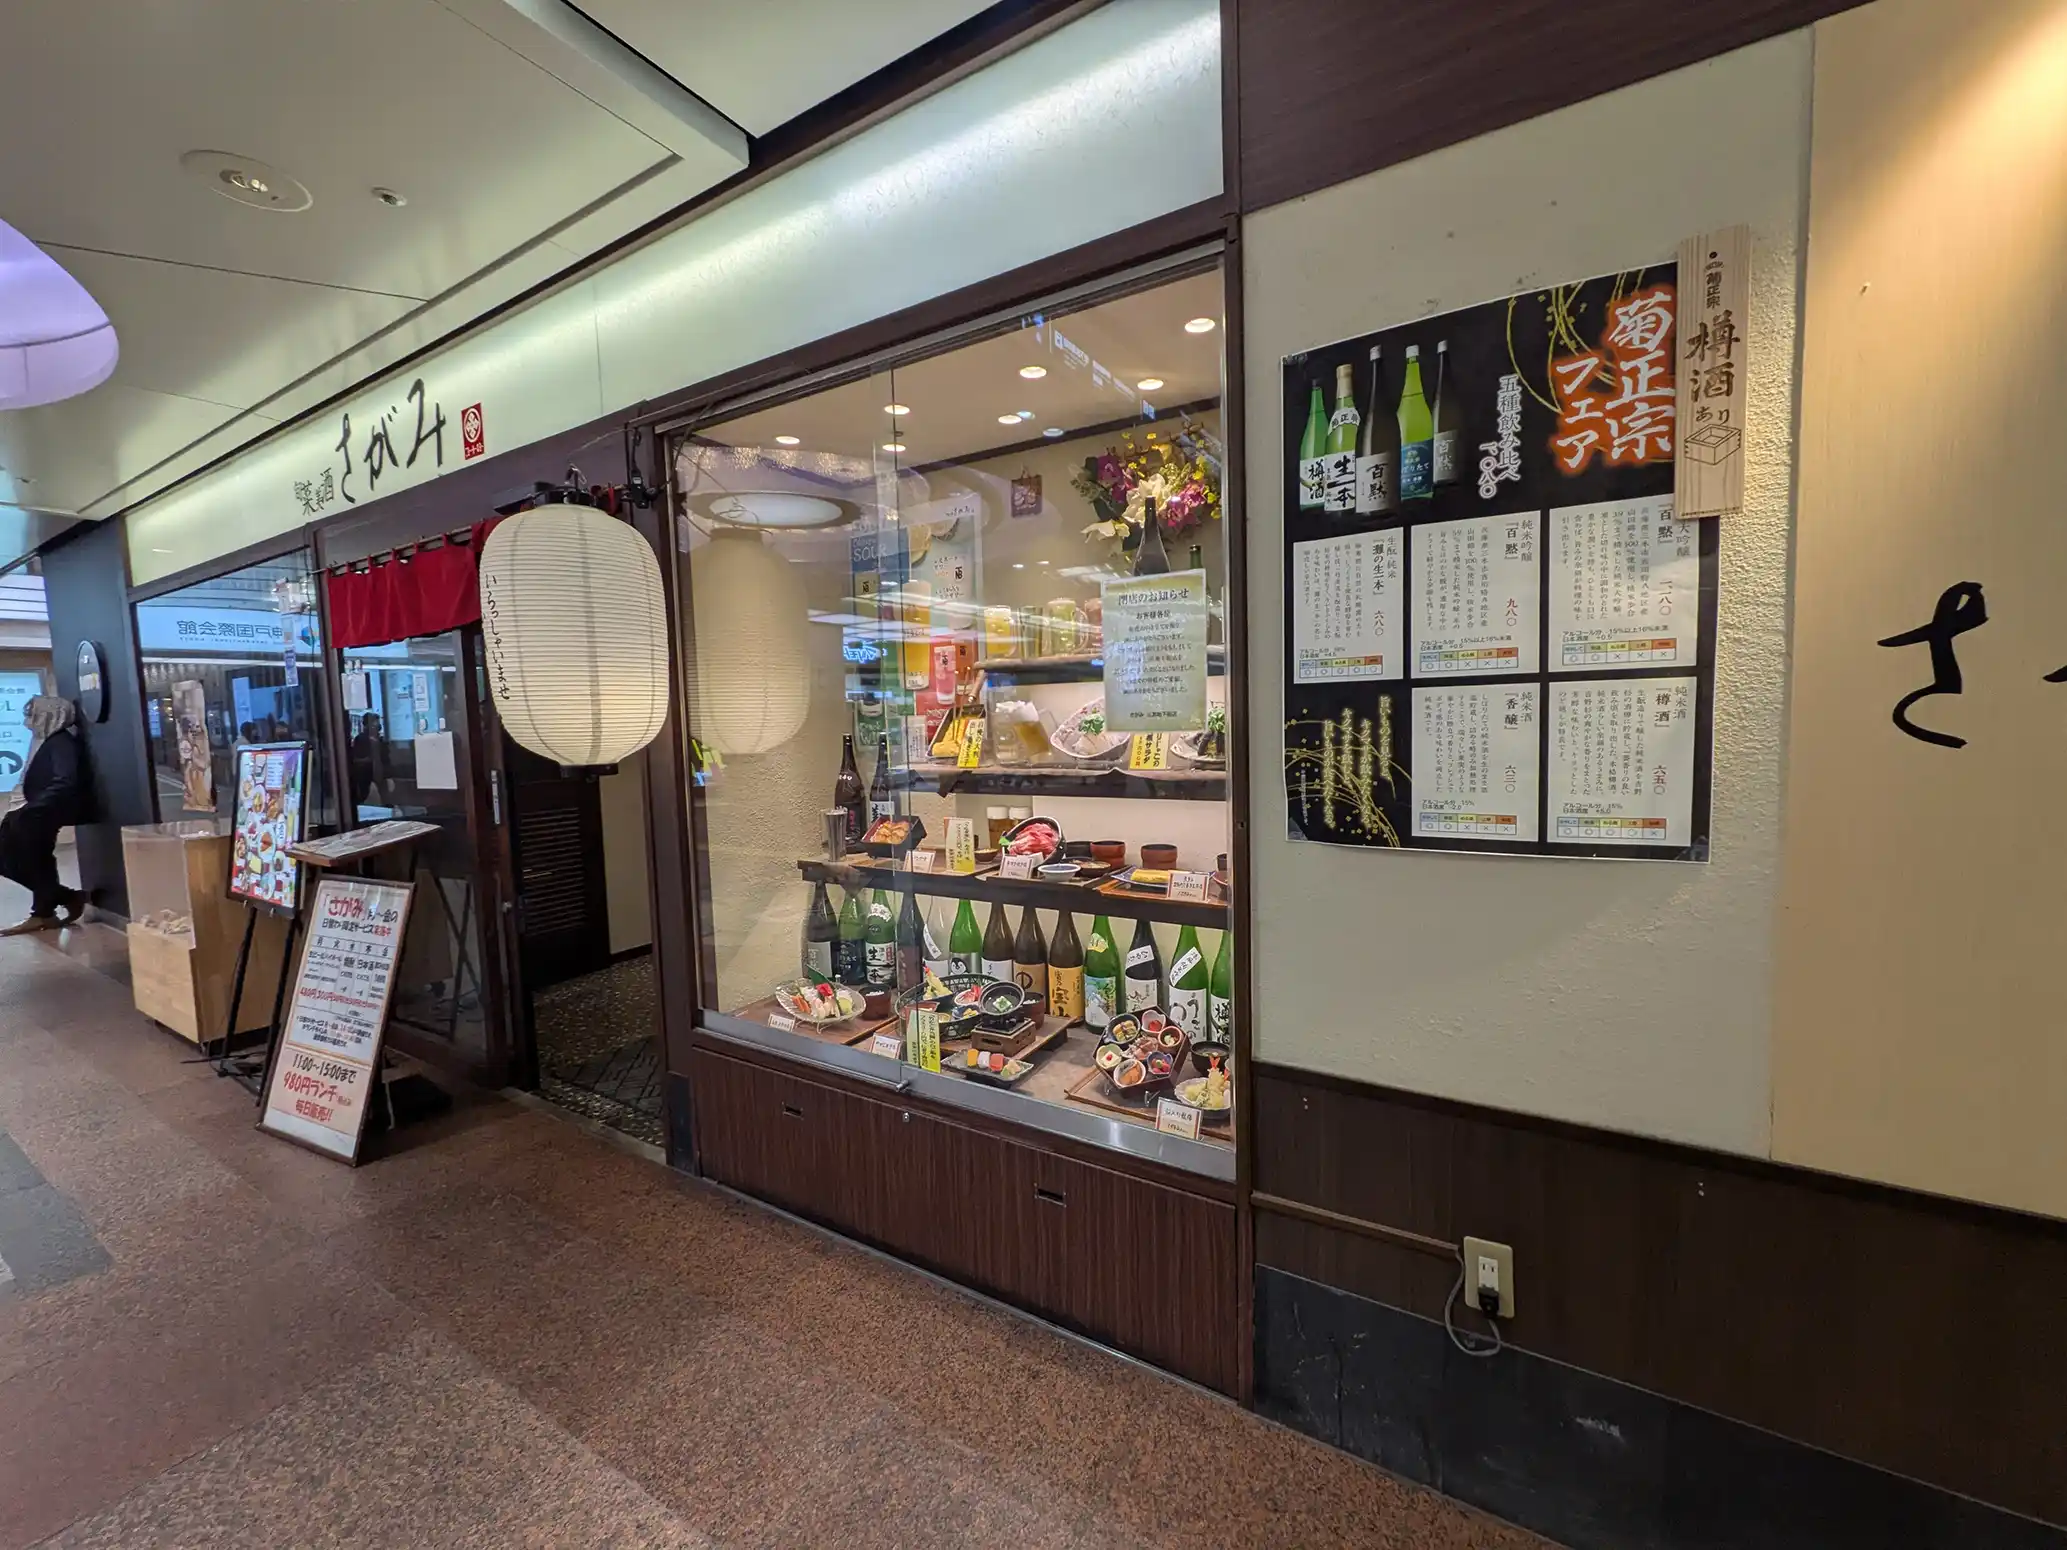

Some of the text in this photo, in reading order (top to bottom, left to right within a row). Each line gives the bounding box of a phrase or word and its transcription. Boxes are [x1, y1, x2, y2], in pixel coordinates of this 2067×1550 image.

[1607, 291, 1676, 459] 菊正宗
[1685, 310, 1741, 402] 樽酒
[1498, 374, 1521, 481] 五種飲み比べ
[1556, 357, 1604, 469] フェア
[1695, 407, 1731, 425] あり
[335, 378, 446, 504] さがみ
[1308, 458, 1325, 500] 樽酒
[1521, 520, 1534, 562] 純米吟醸
[1118, 589, 1190, 606] 閉店のお知らせ
[485, 574, 510, 700] いらっしゃいませ
[1520, 691, 1533, 722] 純米酒
[1674, 686, 1688, 719] 純米酒
[284, 1071, 338, 1102] 980円ランチ
